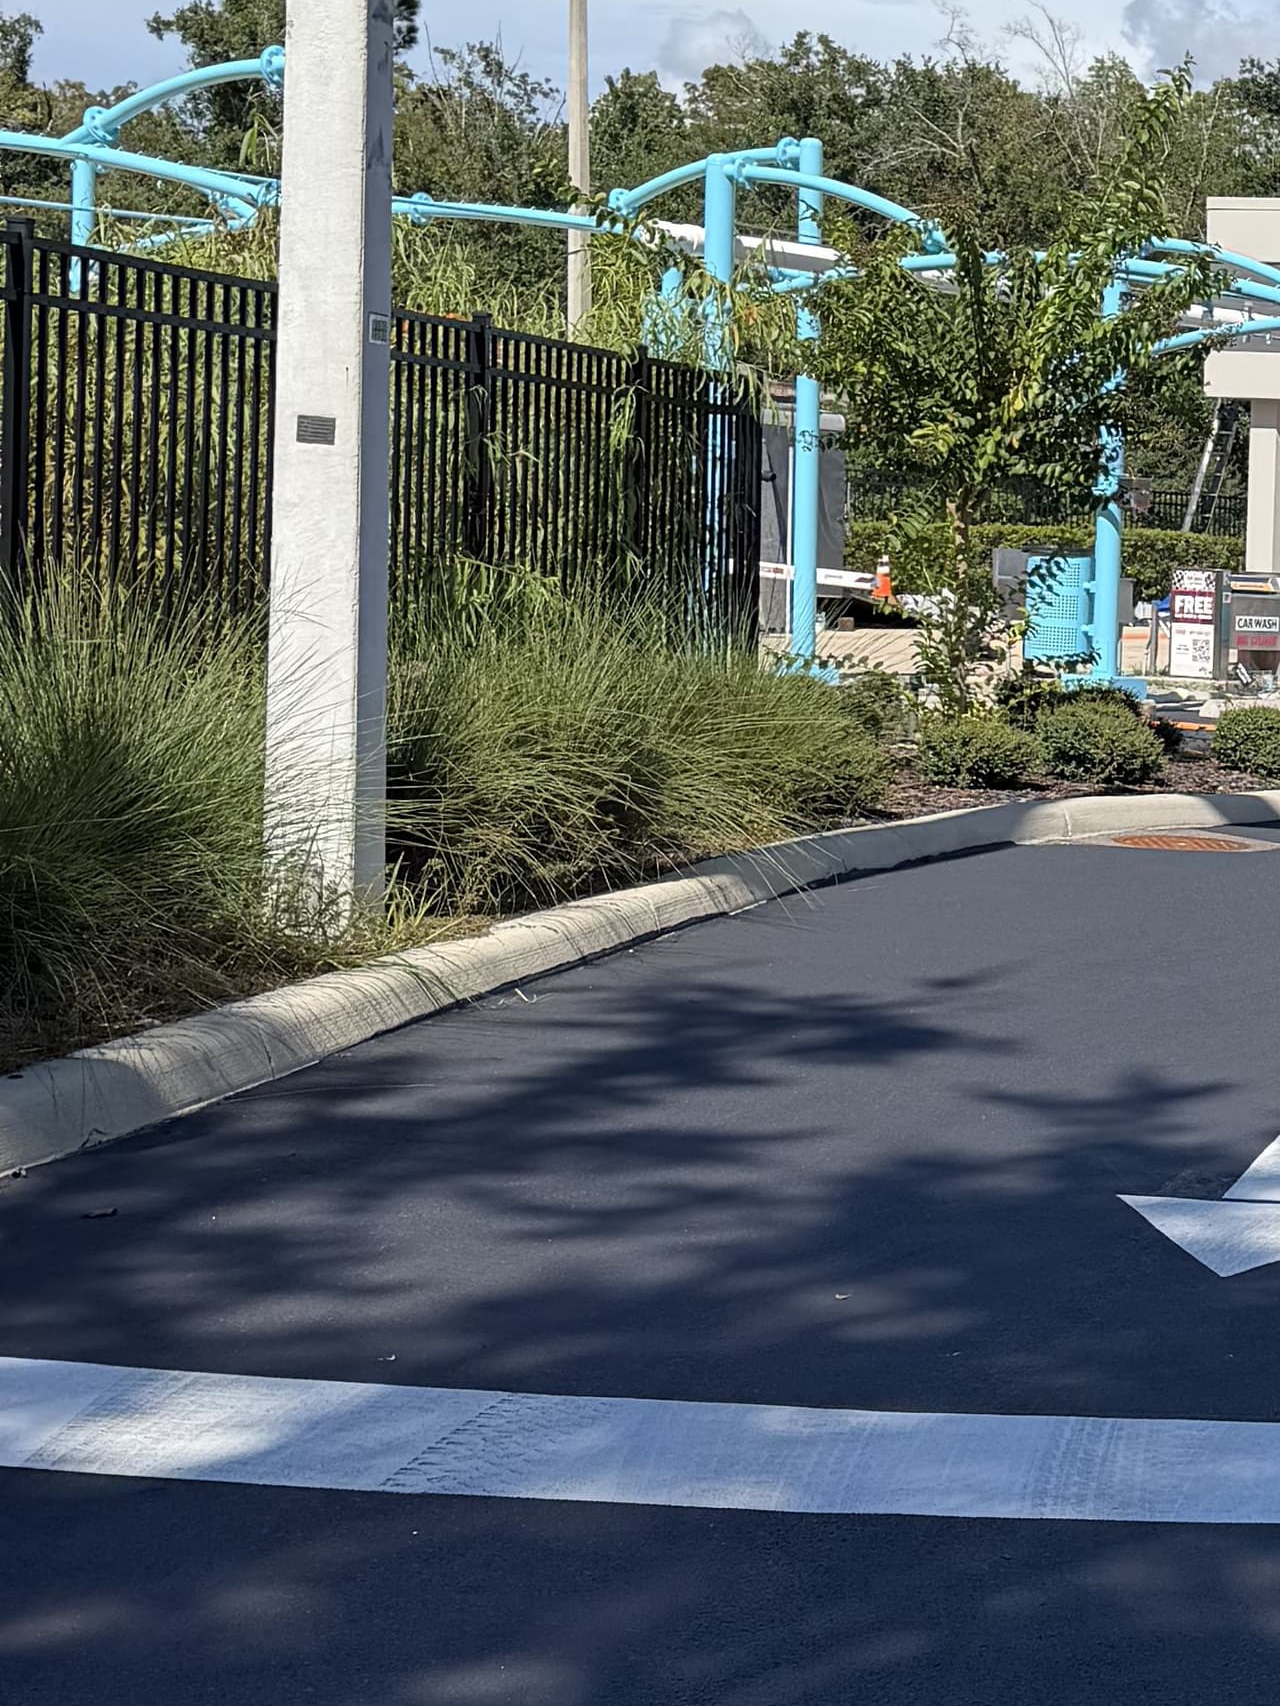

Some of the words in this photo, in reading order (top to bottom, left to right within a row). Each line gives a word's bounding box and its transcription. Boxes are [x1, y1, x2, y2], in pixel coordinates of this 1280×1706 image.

[1175, 595, 1213, 614] FREE
[1237, 618, 1253, 629] CAR
[1254, 618, 1278, 630] WASH
